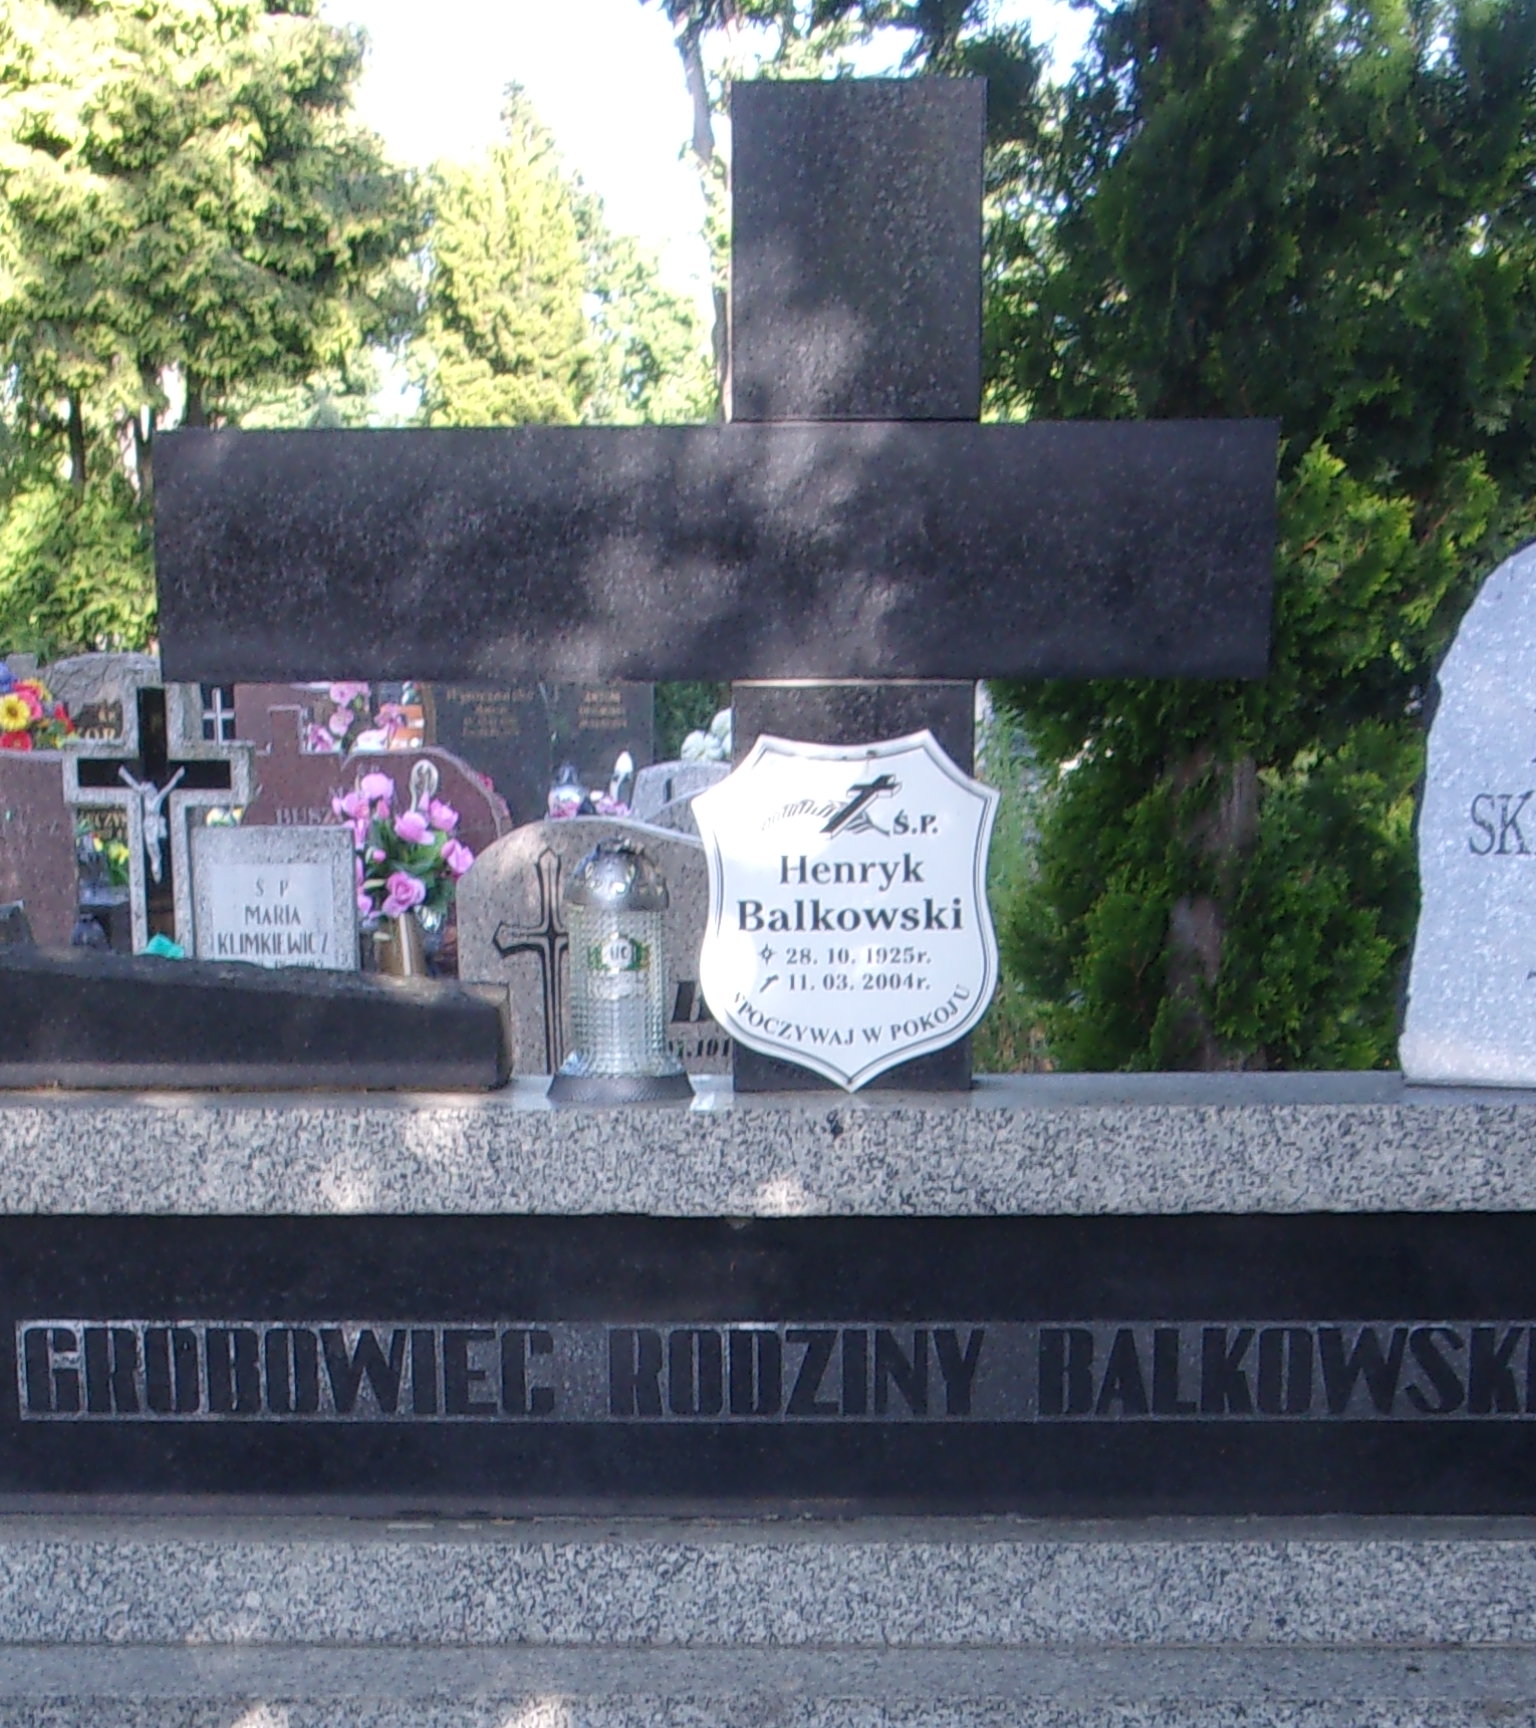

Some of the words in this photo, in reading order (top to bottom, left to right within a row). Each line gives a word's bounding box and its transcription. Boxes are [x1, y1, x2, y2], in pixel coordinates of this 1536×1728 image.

[892, 808, 939, 836] Ś.P.
[779, 852, 925, 892] Henryk
[244, 904, 302, 926] MARIA
[736, 897, 964, 932] Balkowski
[217, 930, 329, 956] KLIMKIEWICZ
[862, 1025, 887, 1045] W
[890, 983, 972, 1042] POKOJU
[22, 1326, 556, 1416] GROBOWIEC
[607, 1327, 986, 1417] RODZINY
